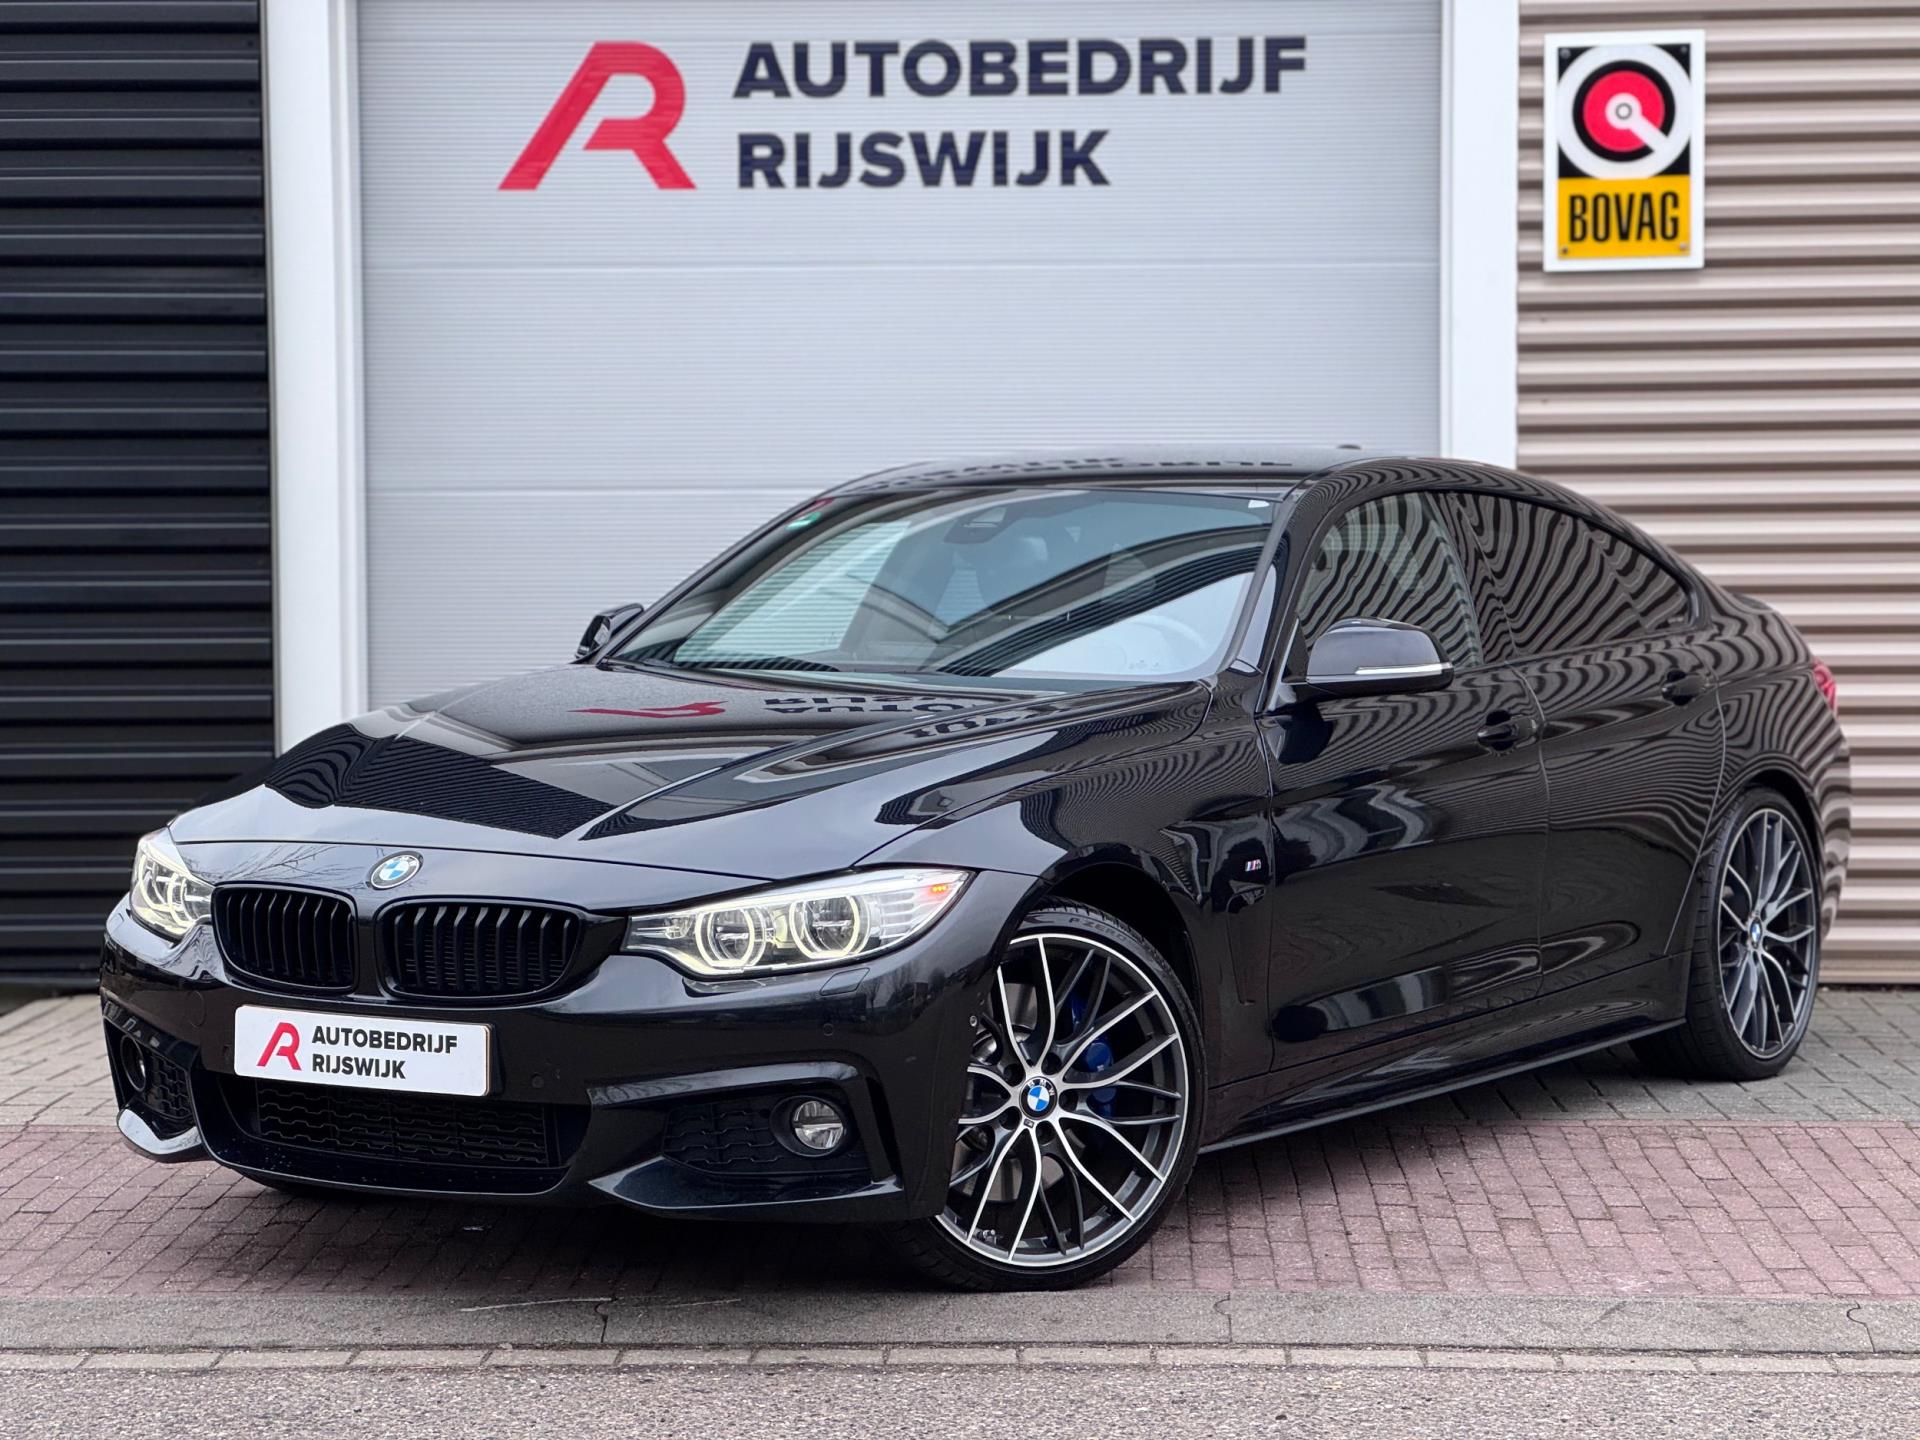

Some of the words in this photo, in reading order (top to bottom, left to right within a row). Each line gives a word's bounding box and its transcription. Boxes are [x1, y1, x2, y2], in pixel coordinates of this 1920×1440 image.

[732, 35, 1307, 99] AUTOBEDRIJF
[738, 130, 1110, 189] RIJSWIJK
[1569, 191, 1680, 243] BOVAG
[311, 1025, 458, 1054] AUTOBEDRIJF
[311, 1053, 406, 1079] RIJSWIJK
[1027, 1079, 1056, 1096] BMW
